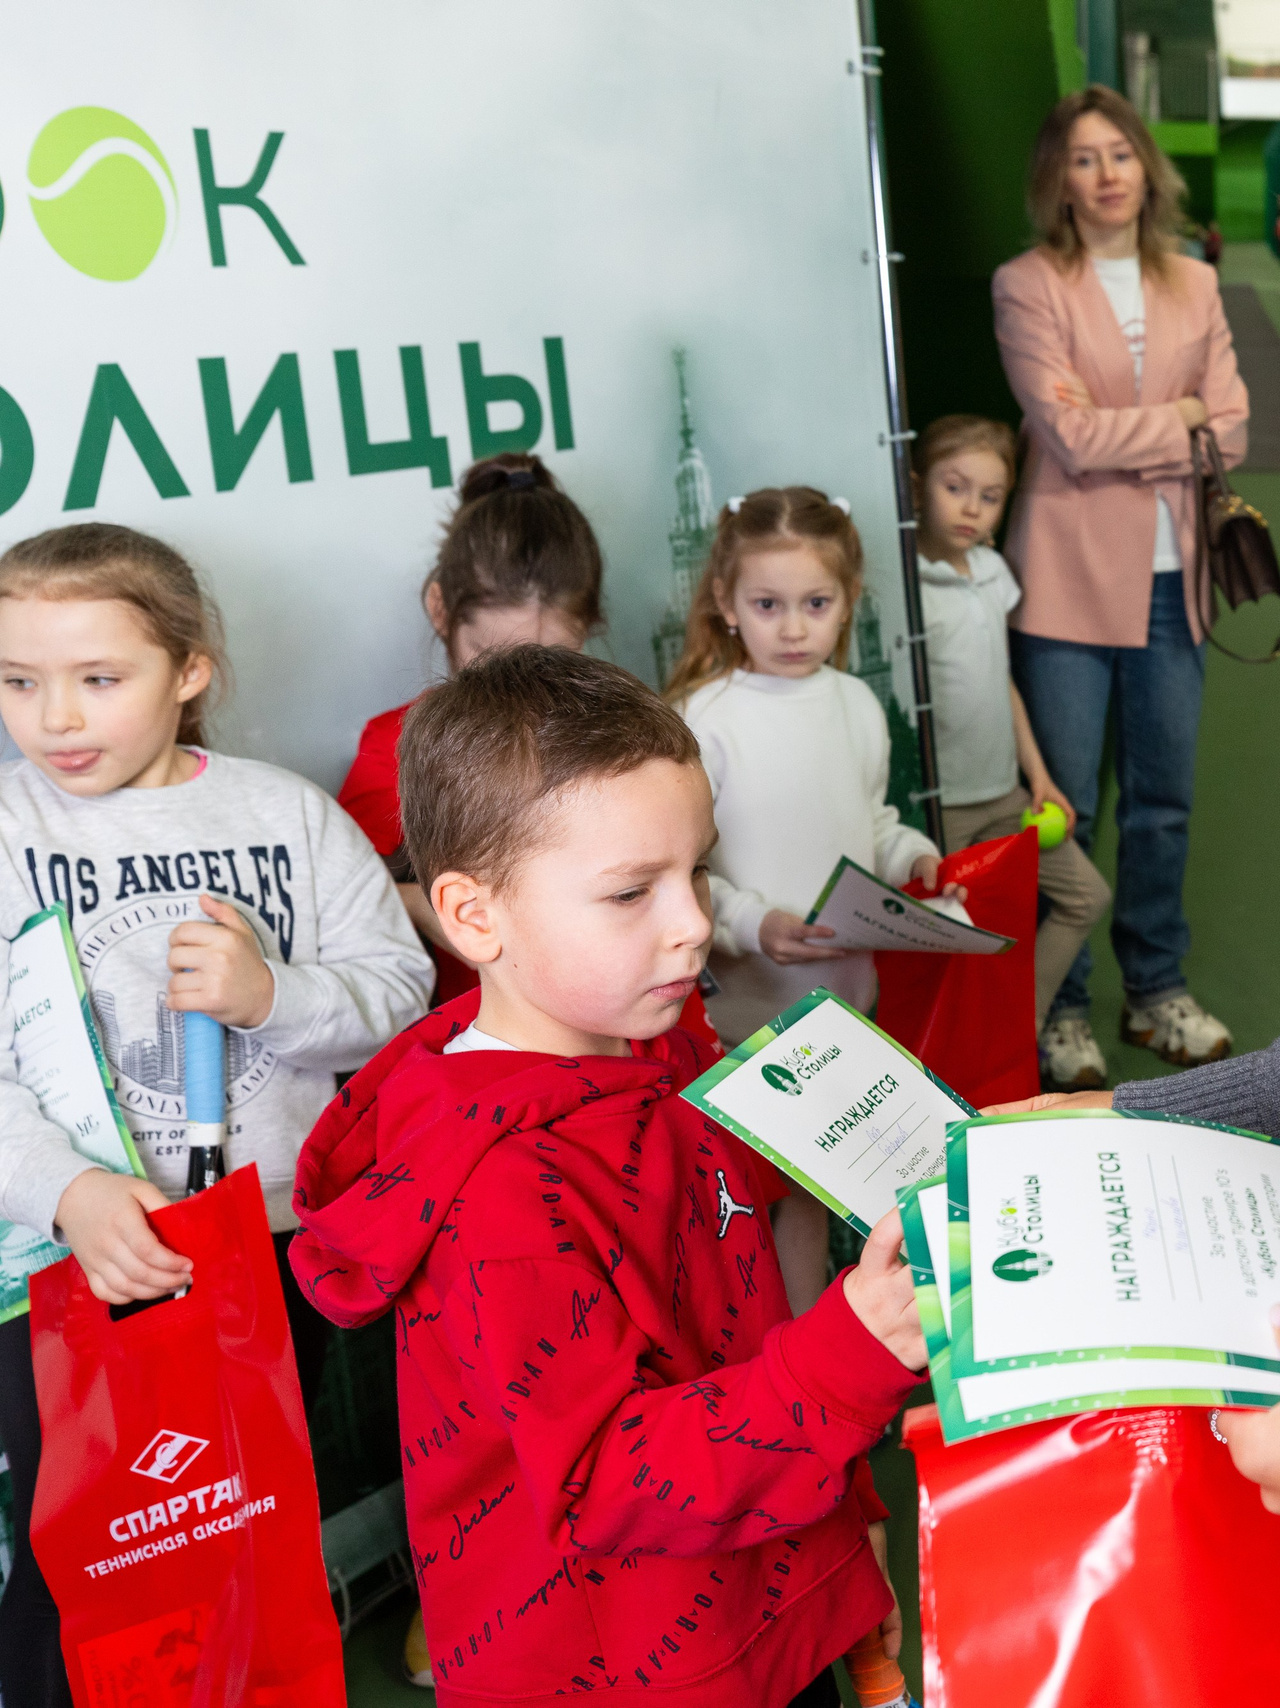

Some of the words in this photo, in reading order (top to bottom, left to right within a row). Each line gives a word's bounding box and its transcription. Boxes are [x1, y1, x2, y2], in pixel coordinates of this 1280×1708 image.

[109, 903, 158, 935] CITY
[115, 845, 293, 964] ANGELES
[796, 1044, 843, 1080] Столицы
[814, 1073, 900, 1153] НАГРАЖДАЕТСЯ
[905, 1146, 930, 1173] участие
[1022, 1174, 1044, 1244] Столицы
[1098, 1152, 1141, 1301] НАГРАЖДАЕТСЯ
[108, 1471, 243, 1543] СПАРТАК
